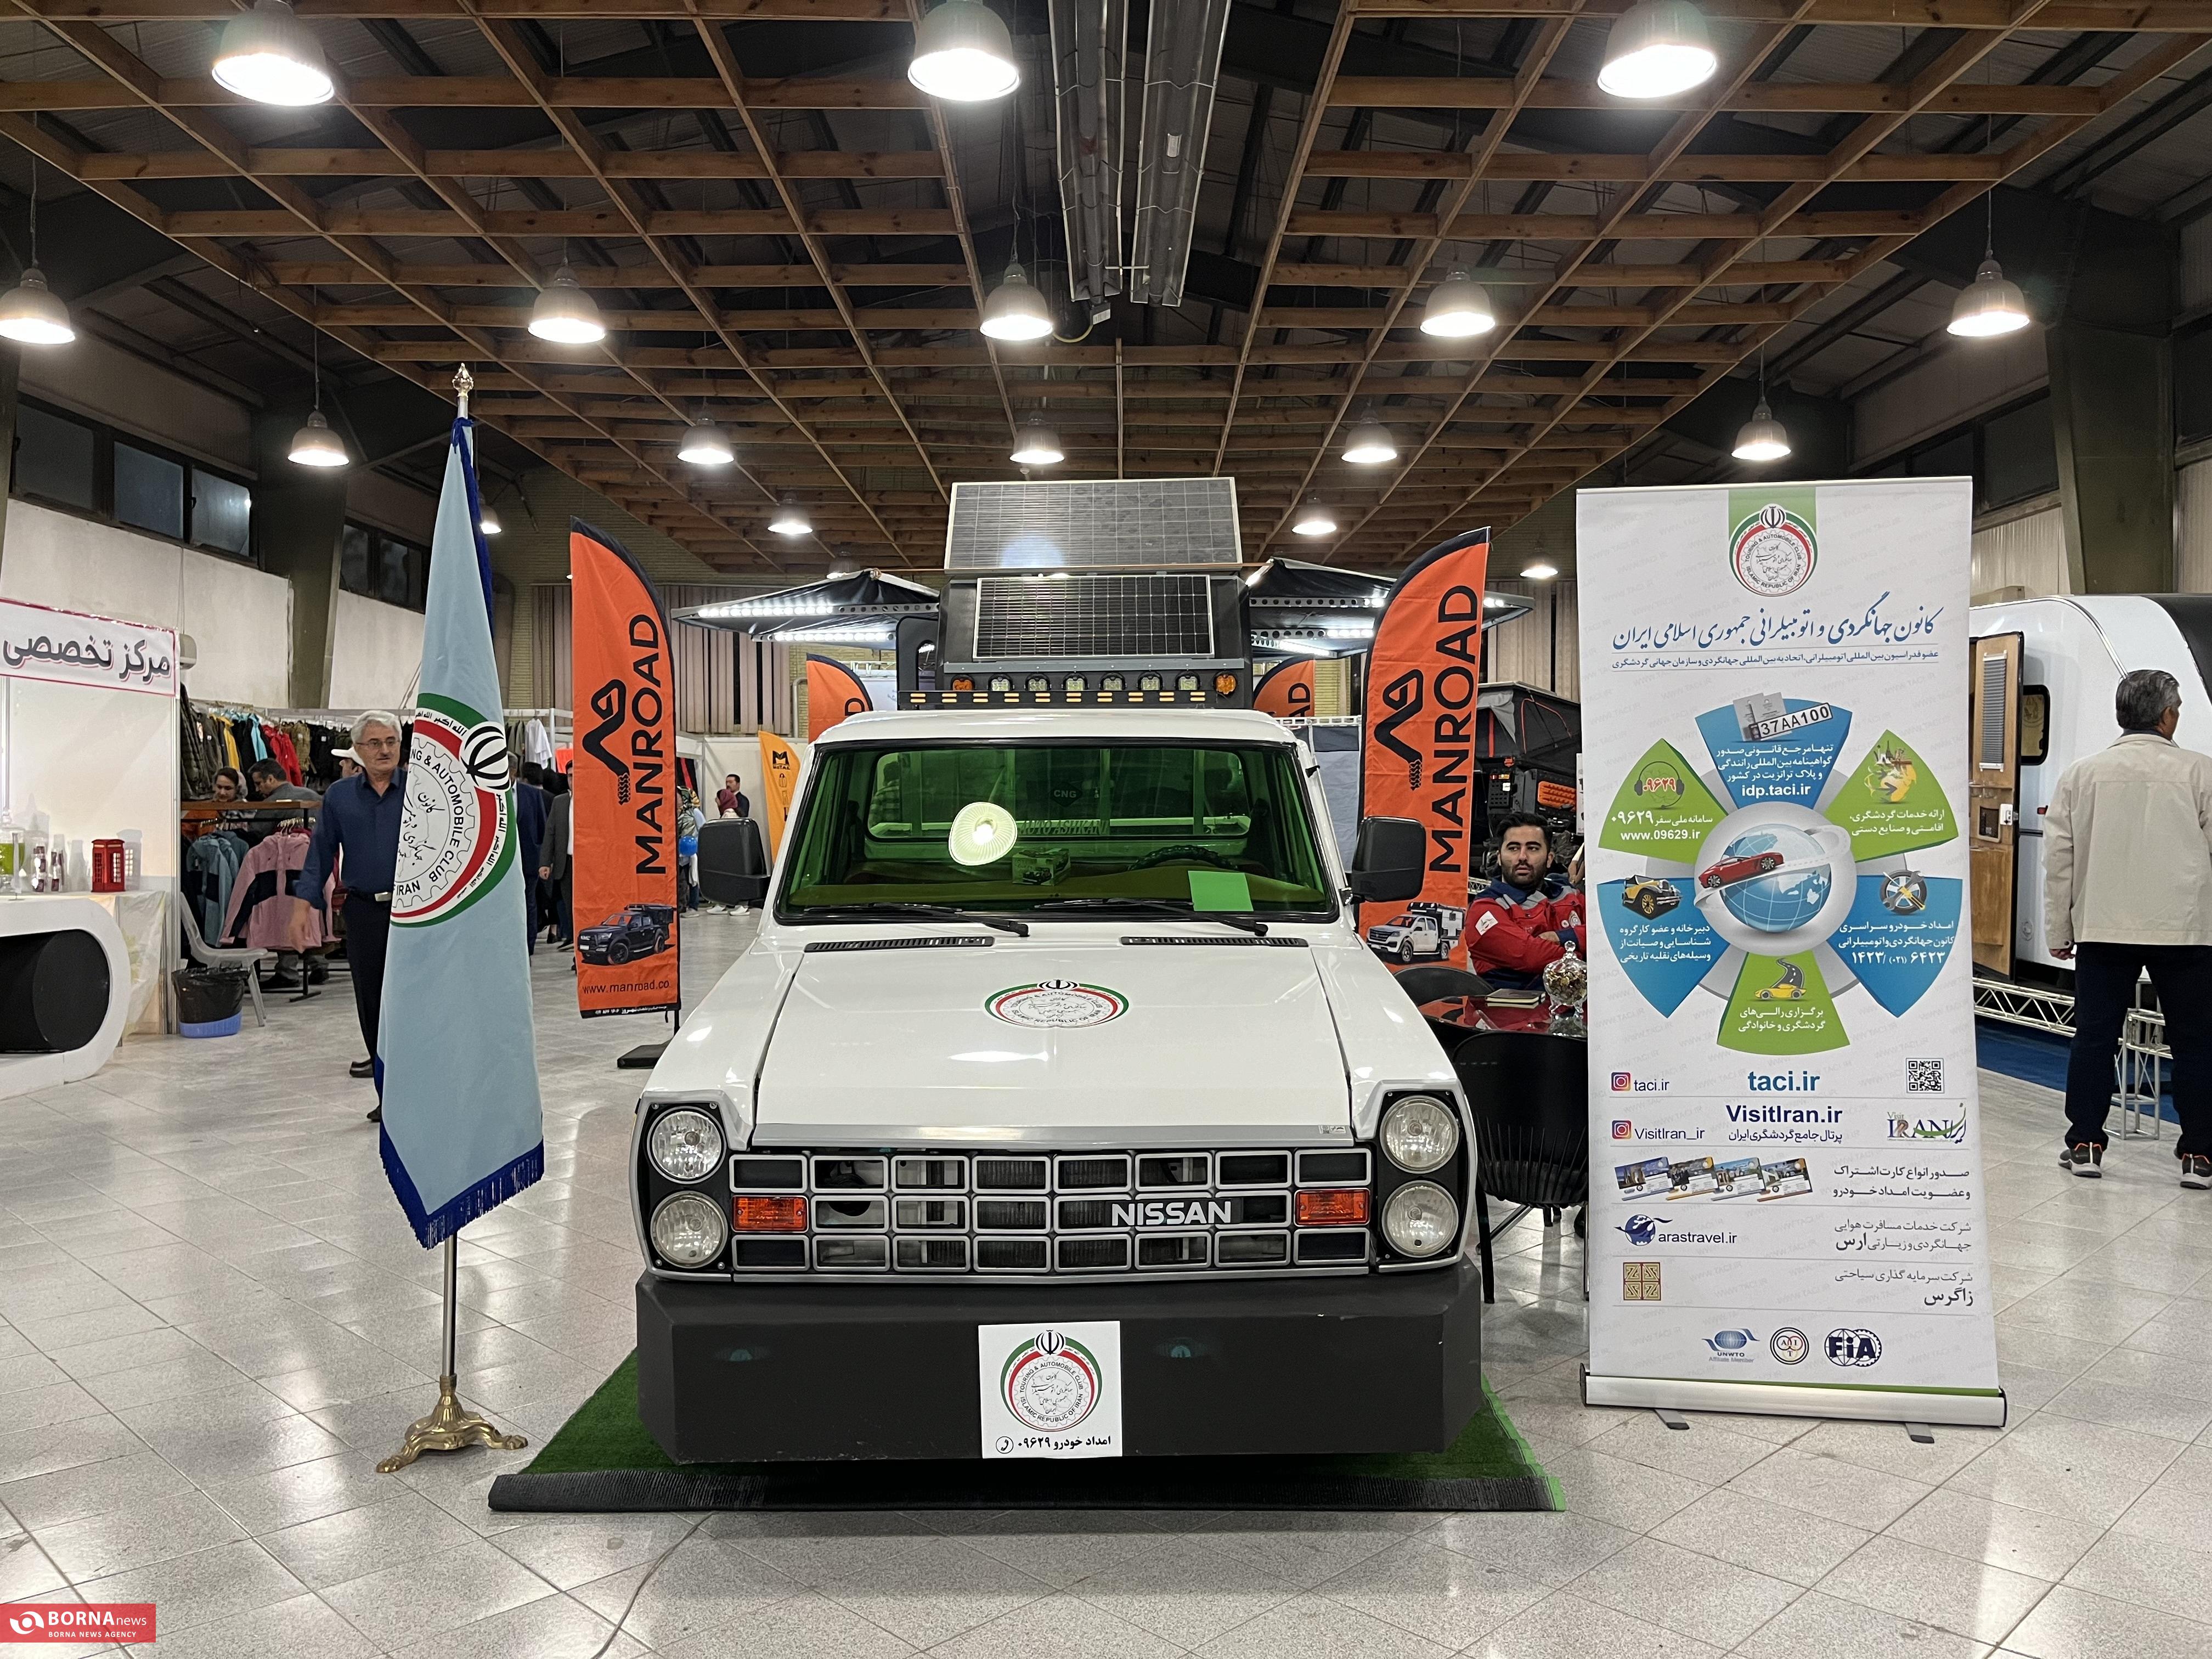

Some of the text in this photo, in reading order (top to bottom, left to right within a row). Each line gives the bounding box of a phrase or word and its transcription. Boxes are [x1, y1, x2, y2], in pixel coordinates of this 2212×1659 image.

[1763, 534, 1795, 547] AUTOMOBILE
[1794, 546, 1802, 560] CLUB
[1828, 591, 1892, 644] جهانگردی
[1894, 606, 1944, 642] کانون
[1613, 626, 1651, 650] ایران
[1654, 622, 1696, 648] اسلامی
[1699, 616, 1751, 648] جمهوری
[2, 634, 171, 682] مرکز تخصصی
[1922, 651, 1938, 660] عضو
[1612, 658, 1649, 669] گردشگری
[1649, 658, 1672, 668] جهانی
[1672, 657, 1697, 667] سازمان
[1702, 657, 1739, 667] جهانگردی
[1760, 706, 1830, 736] 37AA100
[1429, 584, 1479, 874] MANROAD
[629, 613, 667, 874] MANROAD
[1716, 744, 1833, 757] تنها مرجع قانونی صدور
[1718, 758, 1750, 770] رانندگی
[1792, 756, 1832, 768] گواهینامه
[1727, 771, 1750, 782] کشور
[1752, 772, 1760, 782] در
[1762, 770, 1793, 781] ترانزیت
[1795, 769, 1816, 780] پلاک
[1053, 789, 1077, 798] CNG
[1742, 783, 1811, 799] idp.taci.ir
[424, 755, 464, 882] & AUTOMOBILE CLUB
[1672, 815, 1688, 826] ملی
[1688, 815, 1713, 823] سامانه
[1897, 810, 1927, 819] خدمات
[1654, 816, 1671, 826] سفر
[1621, 829, 1700, 840] www.09629.ir
[1852, 826, 1877, 836] دستی
[1878, 824, 1905, 835] صنایع
[1911, 823, 1944, 834] اقامتی
[396, 880, 421, 896] IRAN
[1651, 925, 1669, 935] عضو
[1839, 921, 1954, 933] امداد خودرو سراسری
[1620, 939, 1626, 949] از
[1626, 938, 1658, 948] صیانت
[1664, 937, 1711, 949] شناسایی
[1889, 936, 1933, 947] جهانگردی
[1933, 935, 1955, 947] کانون
[1620, 951, 1649, 963] تاریخی
[1650, 951, 1669, 962] نقلیه
[1785, 1006, 1824, 1018] برگزاری
[1738, 1020, 1776, 1032] خانوادگی
[1782, 1020, 1826, 1031] گردشگری
[1634, 1078, 1670, 1091] taci.ir
[1747, 1070, 1820, 1091] taci.ir
[1725, 1105, 1843, 1124] VisitIran.ir
[1634, 1127, 1705, 1141] VisitIran_ir
[1728, 1128, 1842, 1144] پرتال جامع گردشگری ایران
[1834, 1165, 1970, 1180] صدور انواع کارت اشتراک
[1833, 1186, 1877, 1198] خودرو
[1878, 1186, 1910, 1196] امداد
[1911, 1188, 1965, 1200] عضویت
[1111, 1201, 1232, 1226] NISSAN
[1835, 1218, 1971, 1235] شرکت خدمات مسافرت هوایی
[1658, 1232, 1738, 1244] arastravel.ir
[1836, 1232, 1866, 1251] ارس
[1867, 1238, 1907, 1251] زیارتی
[1913, 1238, 1971, 1252] جهانگردی
[1835, 1268, 1973, 1285] شرکت سرمایه گذاری سیاحتی
[1924, 1287, 1973, 1306] زاگرس
[1019, 1368, 1034, 1393] TOURING
[1040, 1361, 1076, 1376] AUTOMOBILE
[1075, 1375, 1084, 1390] CLUB
[1020, 1393, 1084, 1423] ISLAMIC REPUBLIC OF IRAN
[1053, 1436, 1083, 1451] خودرو
[1086, 1435, 1111, 1446] امداد
